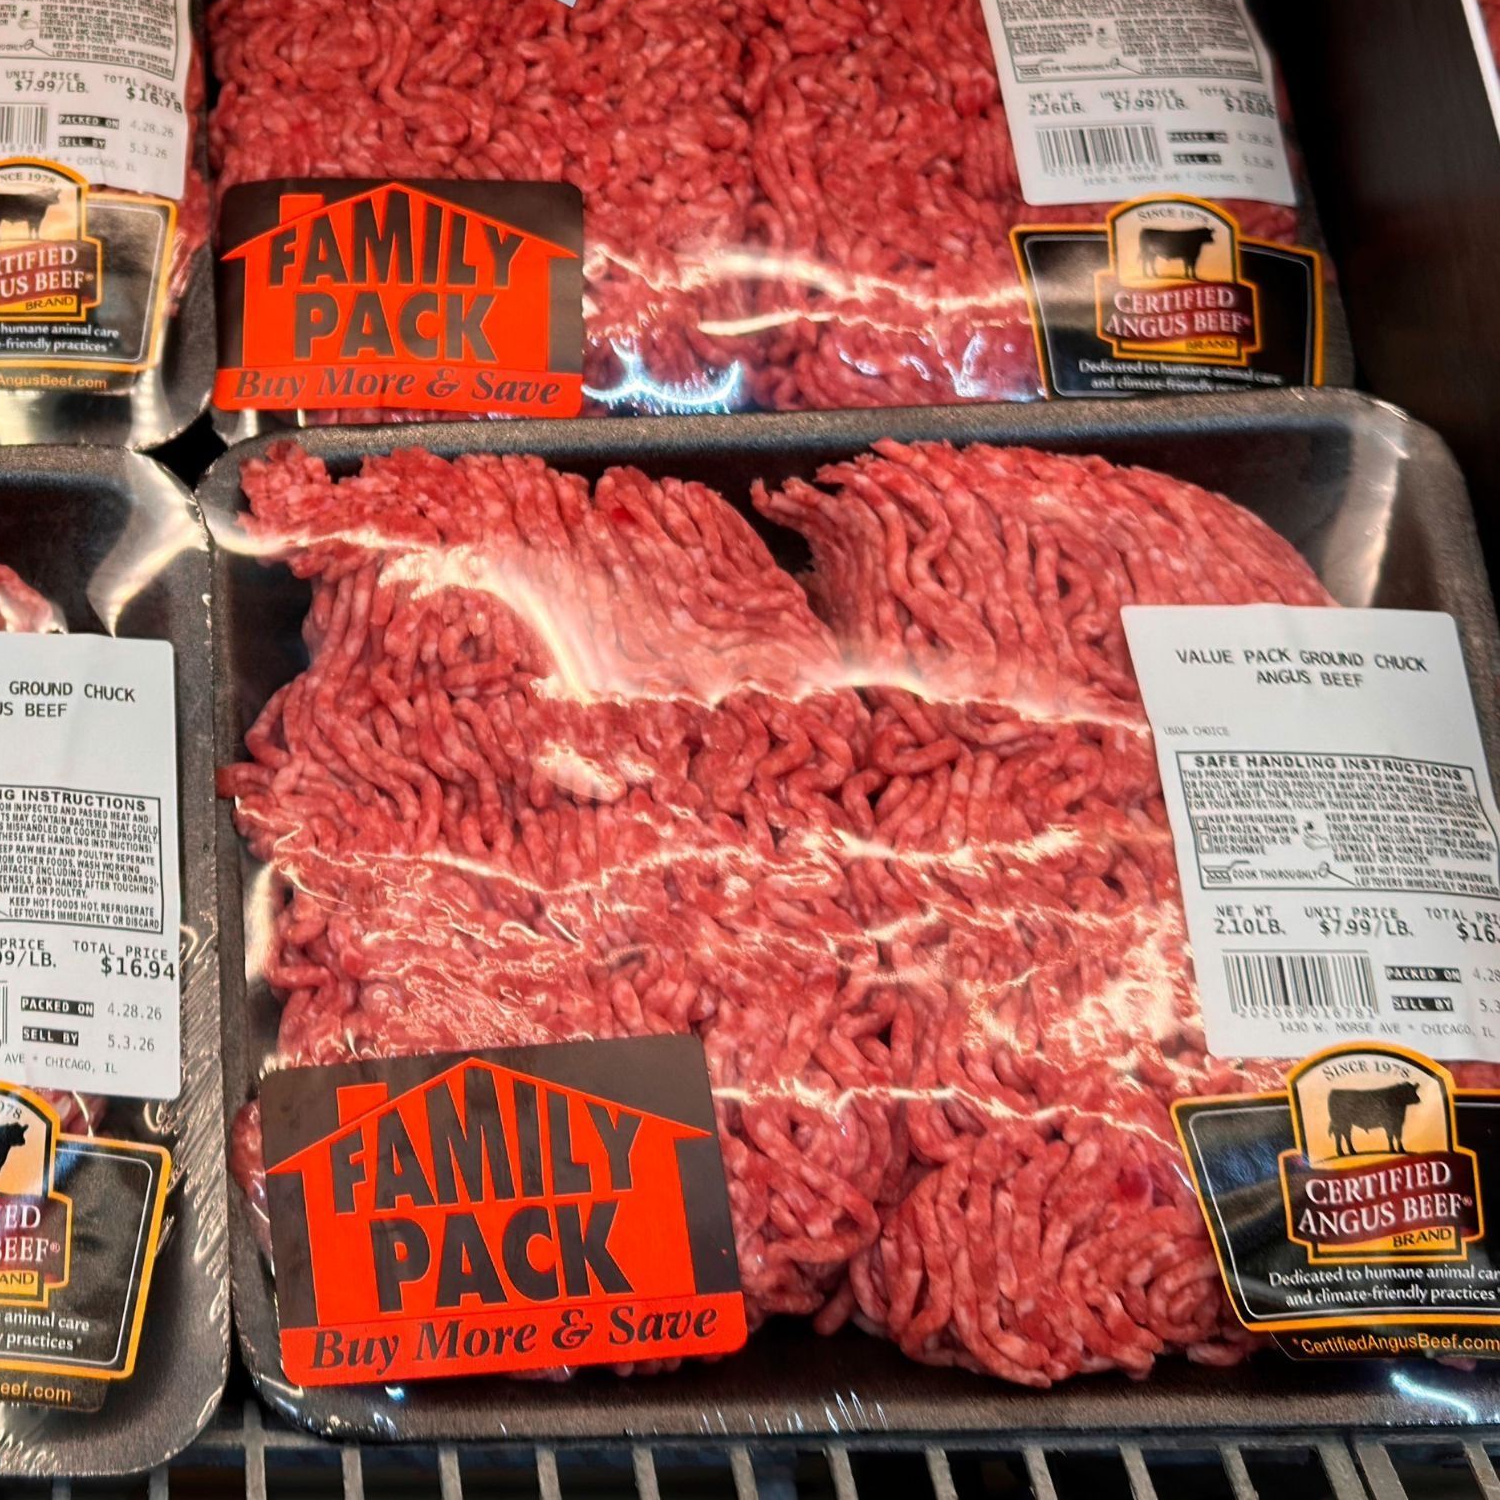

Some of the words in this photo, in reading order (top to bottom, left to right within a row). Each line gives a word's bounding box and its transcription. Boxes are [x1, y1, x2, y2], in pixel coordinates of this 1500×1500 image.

[269, 189, 525, 287] FAMILY
[1114, 286, 1236, 313] CERTIFIED
[294, 291, 498, 362] PACK
[1104, 312, 1187, 337] ANGUS
[235, 368, 306, 407] Buy
[317, 367, 415, 396] More
[425, 368, 460, 398] &
[472, 371, 561, 405] Save
[1176, 649, 1235, 665] VALUE
[1245, 648, 1290, 664] PACK
[1300, 650, 1364, 667] GROUND
[1374, 654, 1428, 673] CHUCK
[1256, 669, 1312, 686] ANGUS
[1320, 672, 1364, 689] BEEF
[9, 681, 74, 696] GROUND
[84, 684, 136, 702] CHUCK
[25, 703, 68, 717] BEEF
[22, 790, 147, 812] INSTRUCTIONS
[0, 938, 45, 952] PRICE
[72, 940, 115, 955] TOTAL
[125, 945, 168, 961] PRICE
[100, 957, 176, 981] $16.94
[21, 998, 70, 1014] PACKED
[78, 1003, 94, 1016] ON
[107, 1004, 163, 1021] 4.28.26
[22, 1027, 55, 1043] SELL
[62, 1031, 79, 1044] BY
[108, 1035, 156, 1052] 5.3.26
[4, 1053, 25, 1064] AVE
[44, 1056, 97, 1072] CHICAGO,
[104, 1062, 118, 1074] IL
[1322, 1060, 1369, 1081] SINCE
[329, 1065, 644, 1215] FAMILY
[1305, 1161, 1451, 1205] CERTIFIED
[1298, 1204, 1396, 1238] ANGUS
[1392, 1227, 1452, 1248] BRAND
[369, 1201, 635, 1312] PACK
[4, 1310, 55, 1329] animal
[58, 1315, 90, 1331] care
[310, 1330, 399, 1376] Buy
[412, 1320, 537, 1361] More
[551, 1309, 594, 1350] &
[608, 1306, 719, 1345] Save
